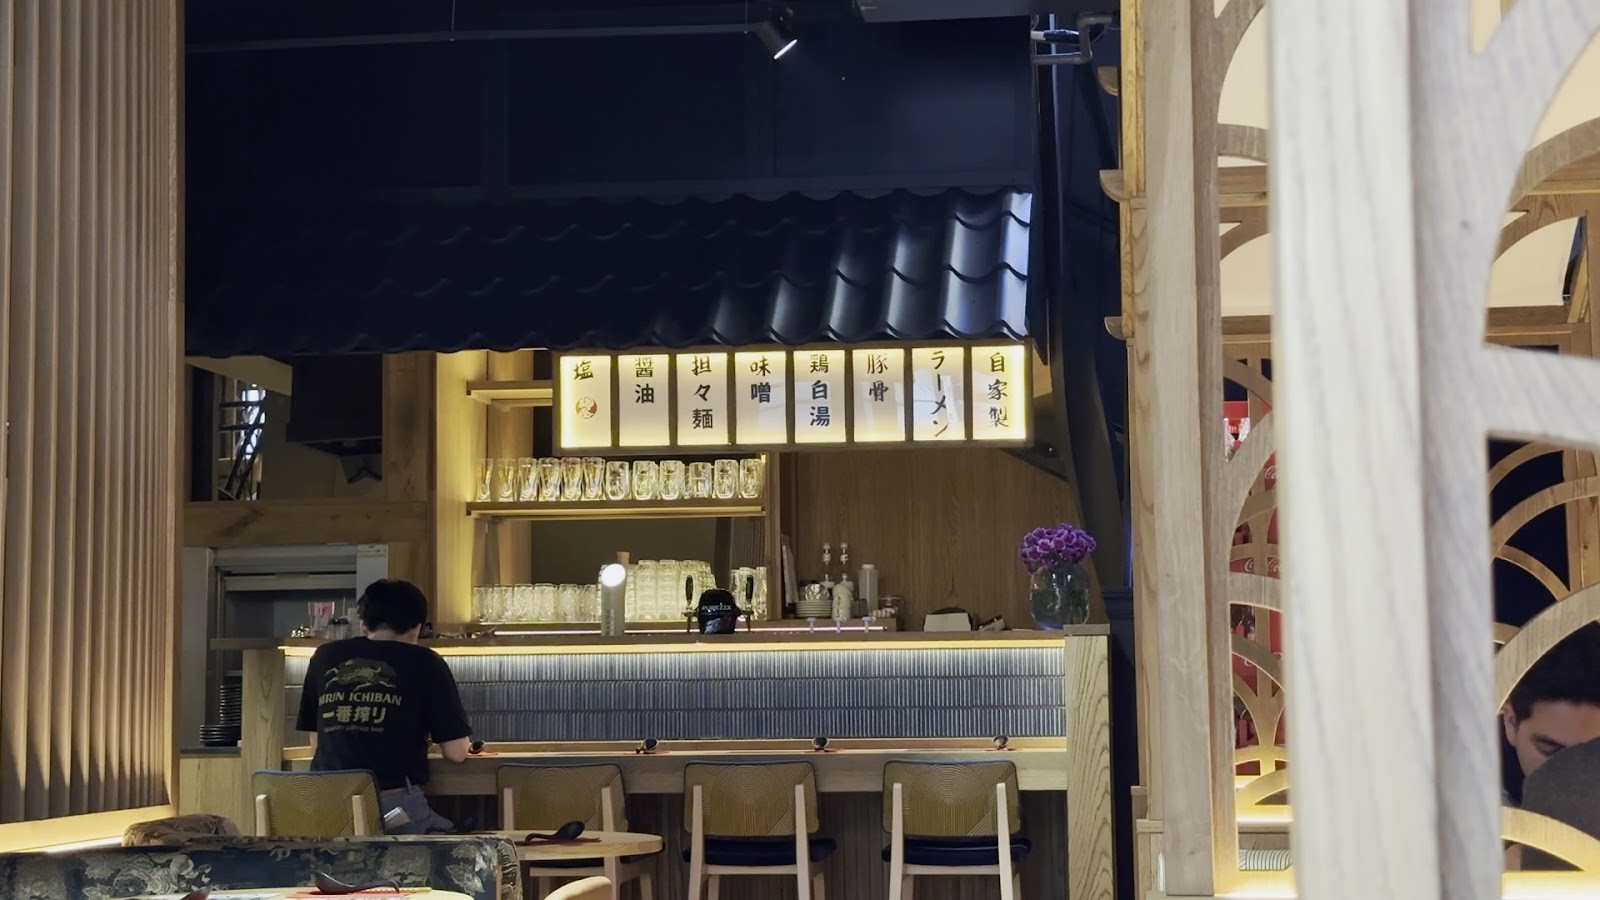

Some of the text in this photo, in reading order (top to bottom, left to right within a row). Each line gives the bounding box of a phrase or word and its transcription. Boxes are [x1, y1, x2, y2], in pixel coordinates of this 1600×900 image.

[573, 360, 594, 380] 塩
[749, 356, 771, 403] 味噌
[809, 353, 831, 427] 鶏白湯
[867, 353, 889, 402] 豚骨
[931, 350, 950, 437] ラーメン
[988, 352, 1009, 428] 自家製
[348, 692, 402, 706] ICHIBAN
